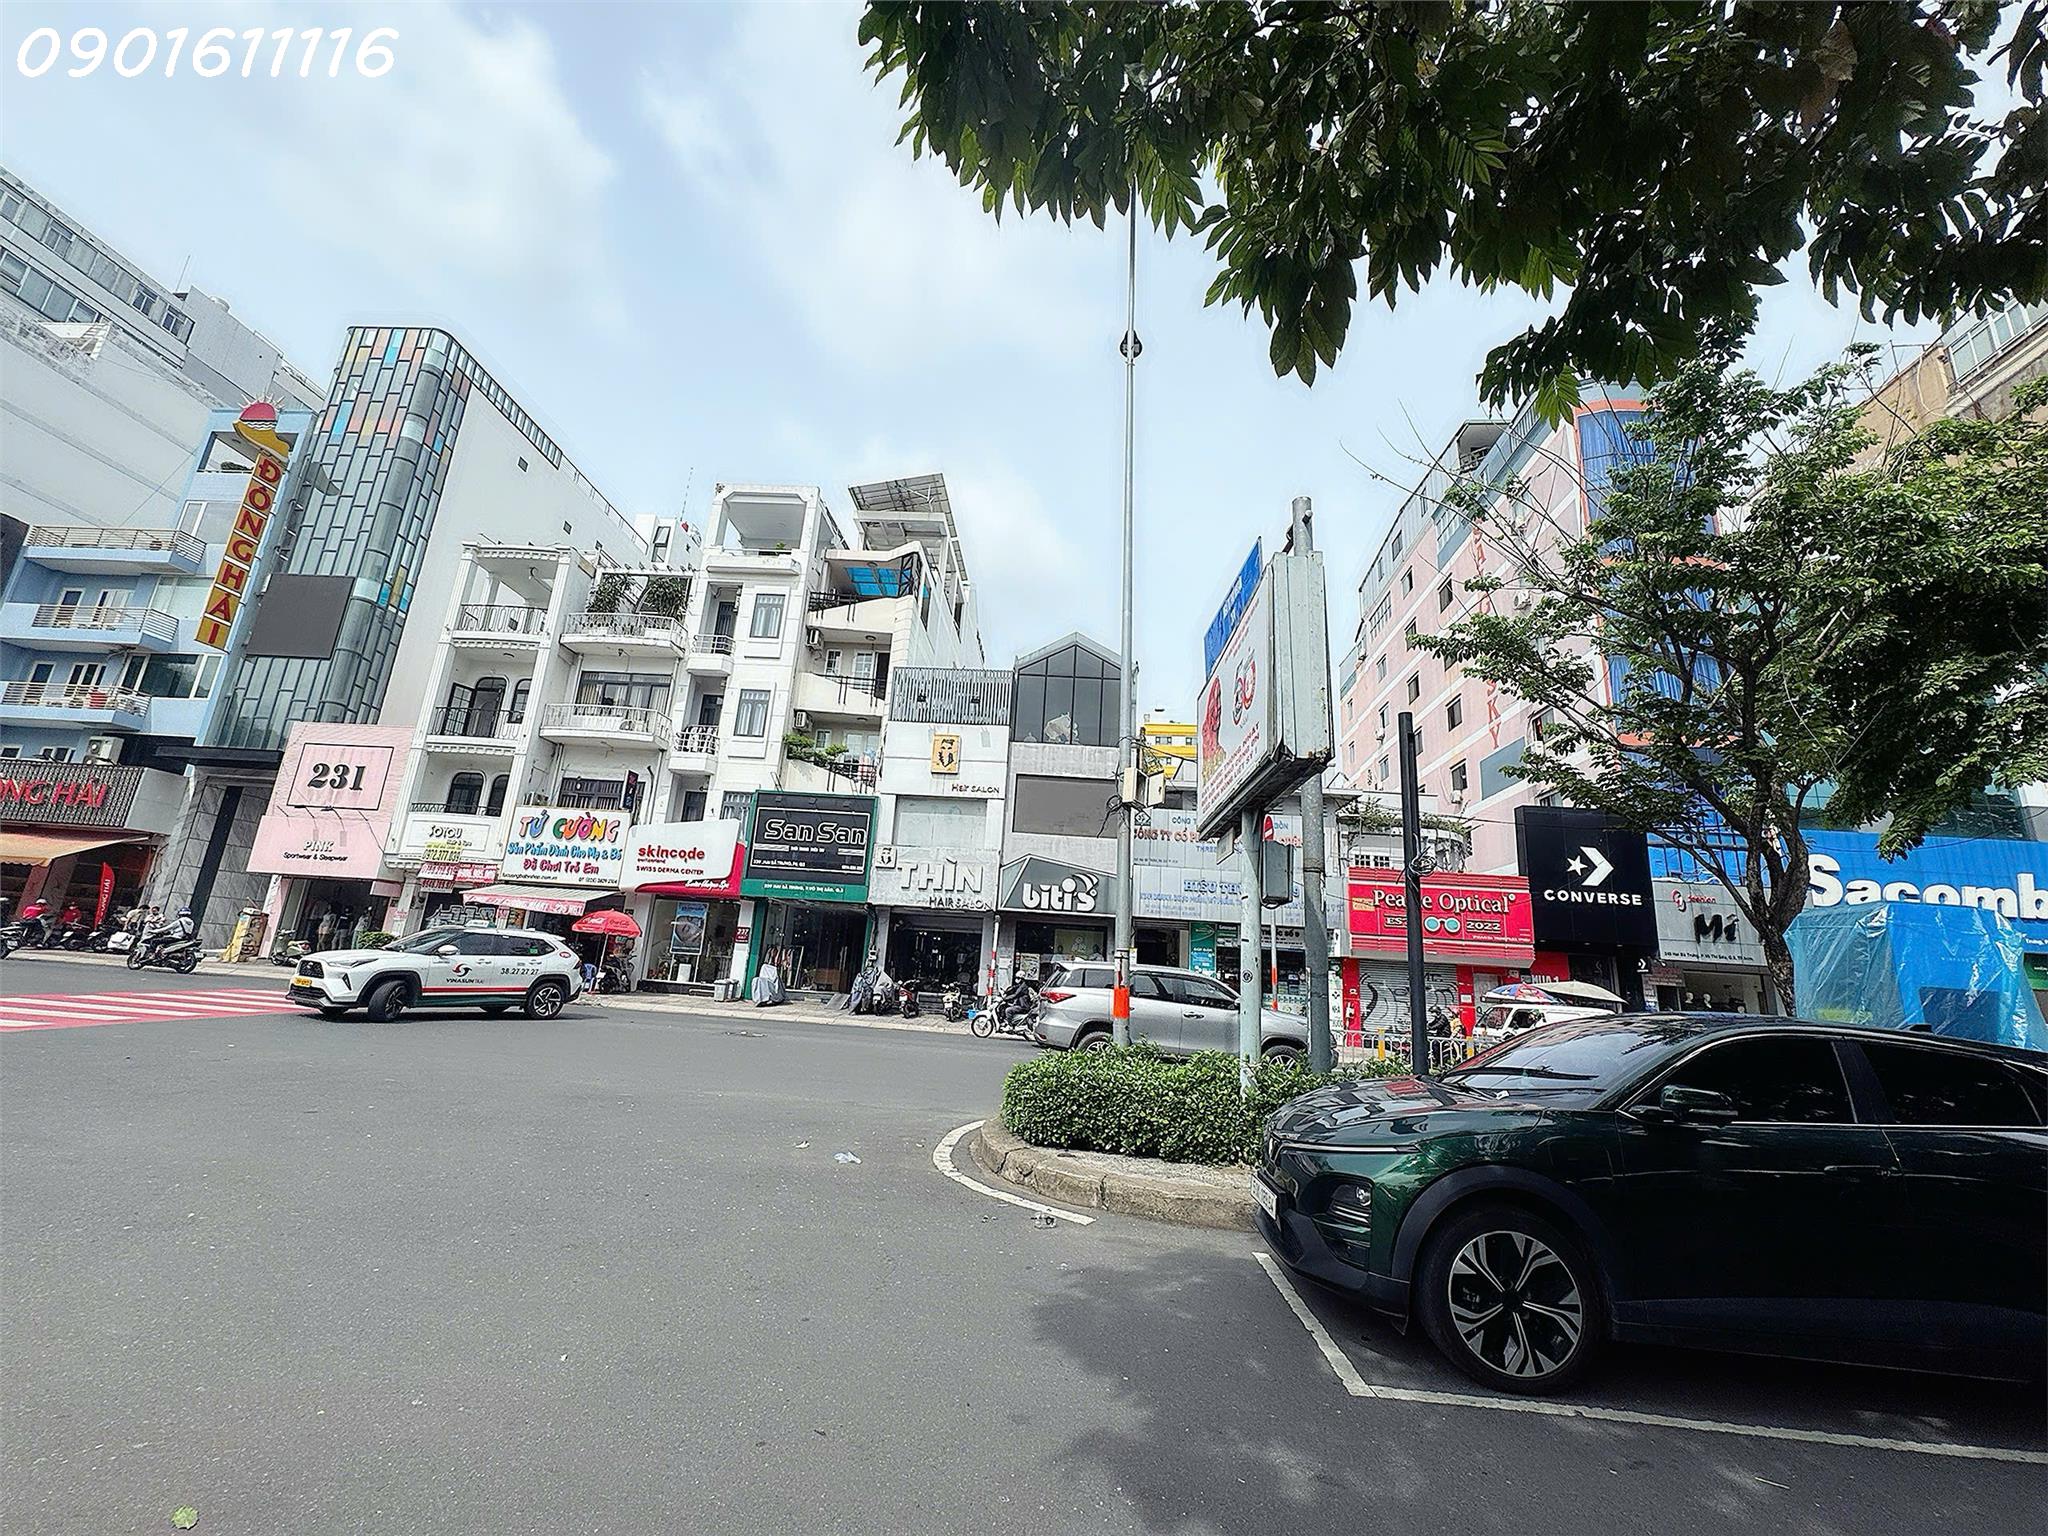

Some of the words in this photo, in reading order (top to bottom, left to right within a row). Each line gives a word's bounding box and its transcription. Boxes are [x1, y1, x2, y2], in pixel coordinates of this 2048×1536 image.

[307, 763, 366, 791] 231
[0, 774, 48, 805] NG
[971, 785, 1000, 794] SALON
[519, 809, 550, 838] TỬ
[553, 812, 621, 843] CƯỜNG
[764, 819, 814, 842] San
[816, 822, 867, 845] San
[304, 840, 335, 852] PINK
[508, 842, 523, 855] Sản
[525, 842, 547, 857] Phẩm
[549, 844, 569, 857] Dành
[571, 845, 586, 858] Cho
[638, 845, 705, 861] skincode
[523, 858, 537, 871] Đồ
[540, 859, 561, 873] Chơi
[583, 862, 599, 875] Em
[897, 857, 983, 893] THÌN
[930, 896, 954, 909] HAIR
[955, 897, 993, 911] SALON
[1373, 889, 1433, 909] Peae
[1439, 893, 1509, 915] Optical
[1544, 889, 1643, 906] CONVERSE
[1466, 921, 1501, 930] 2022
